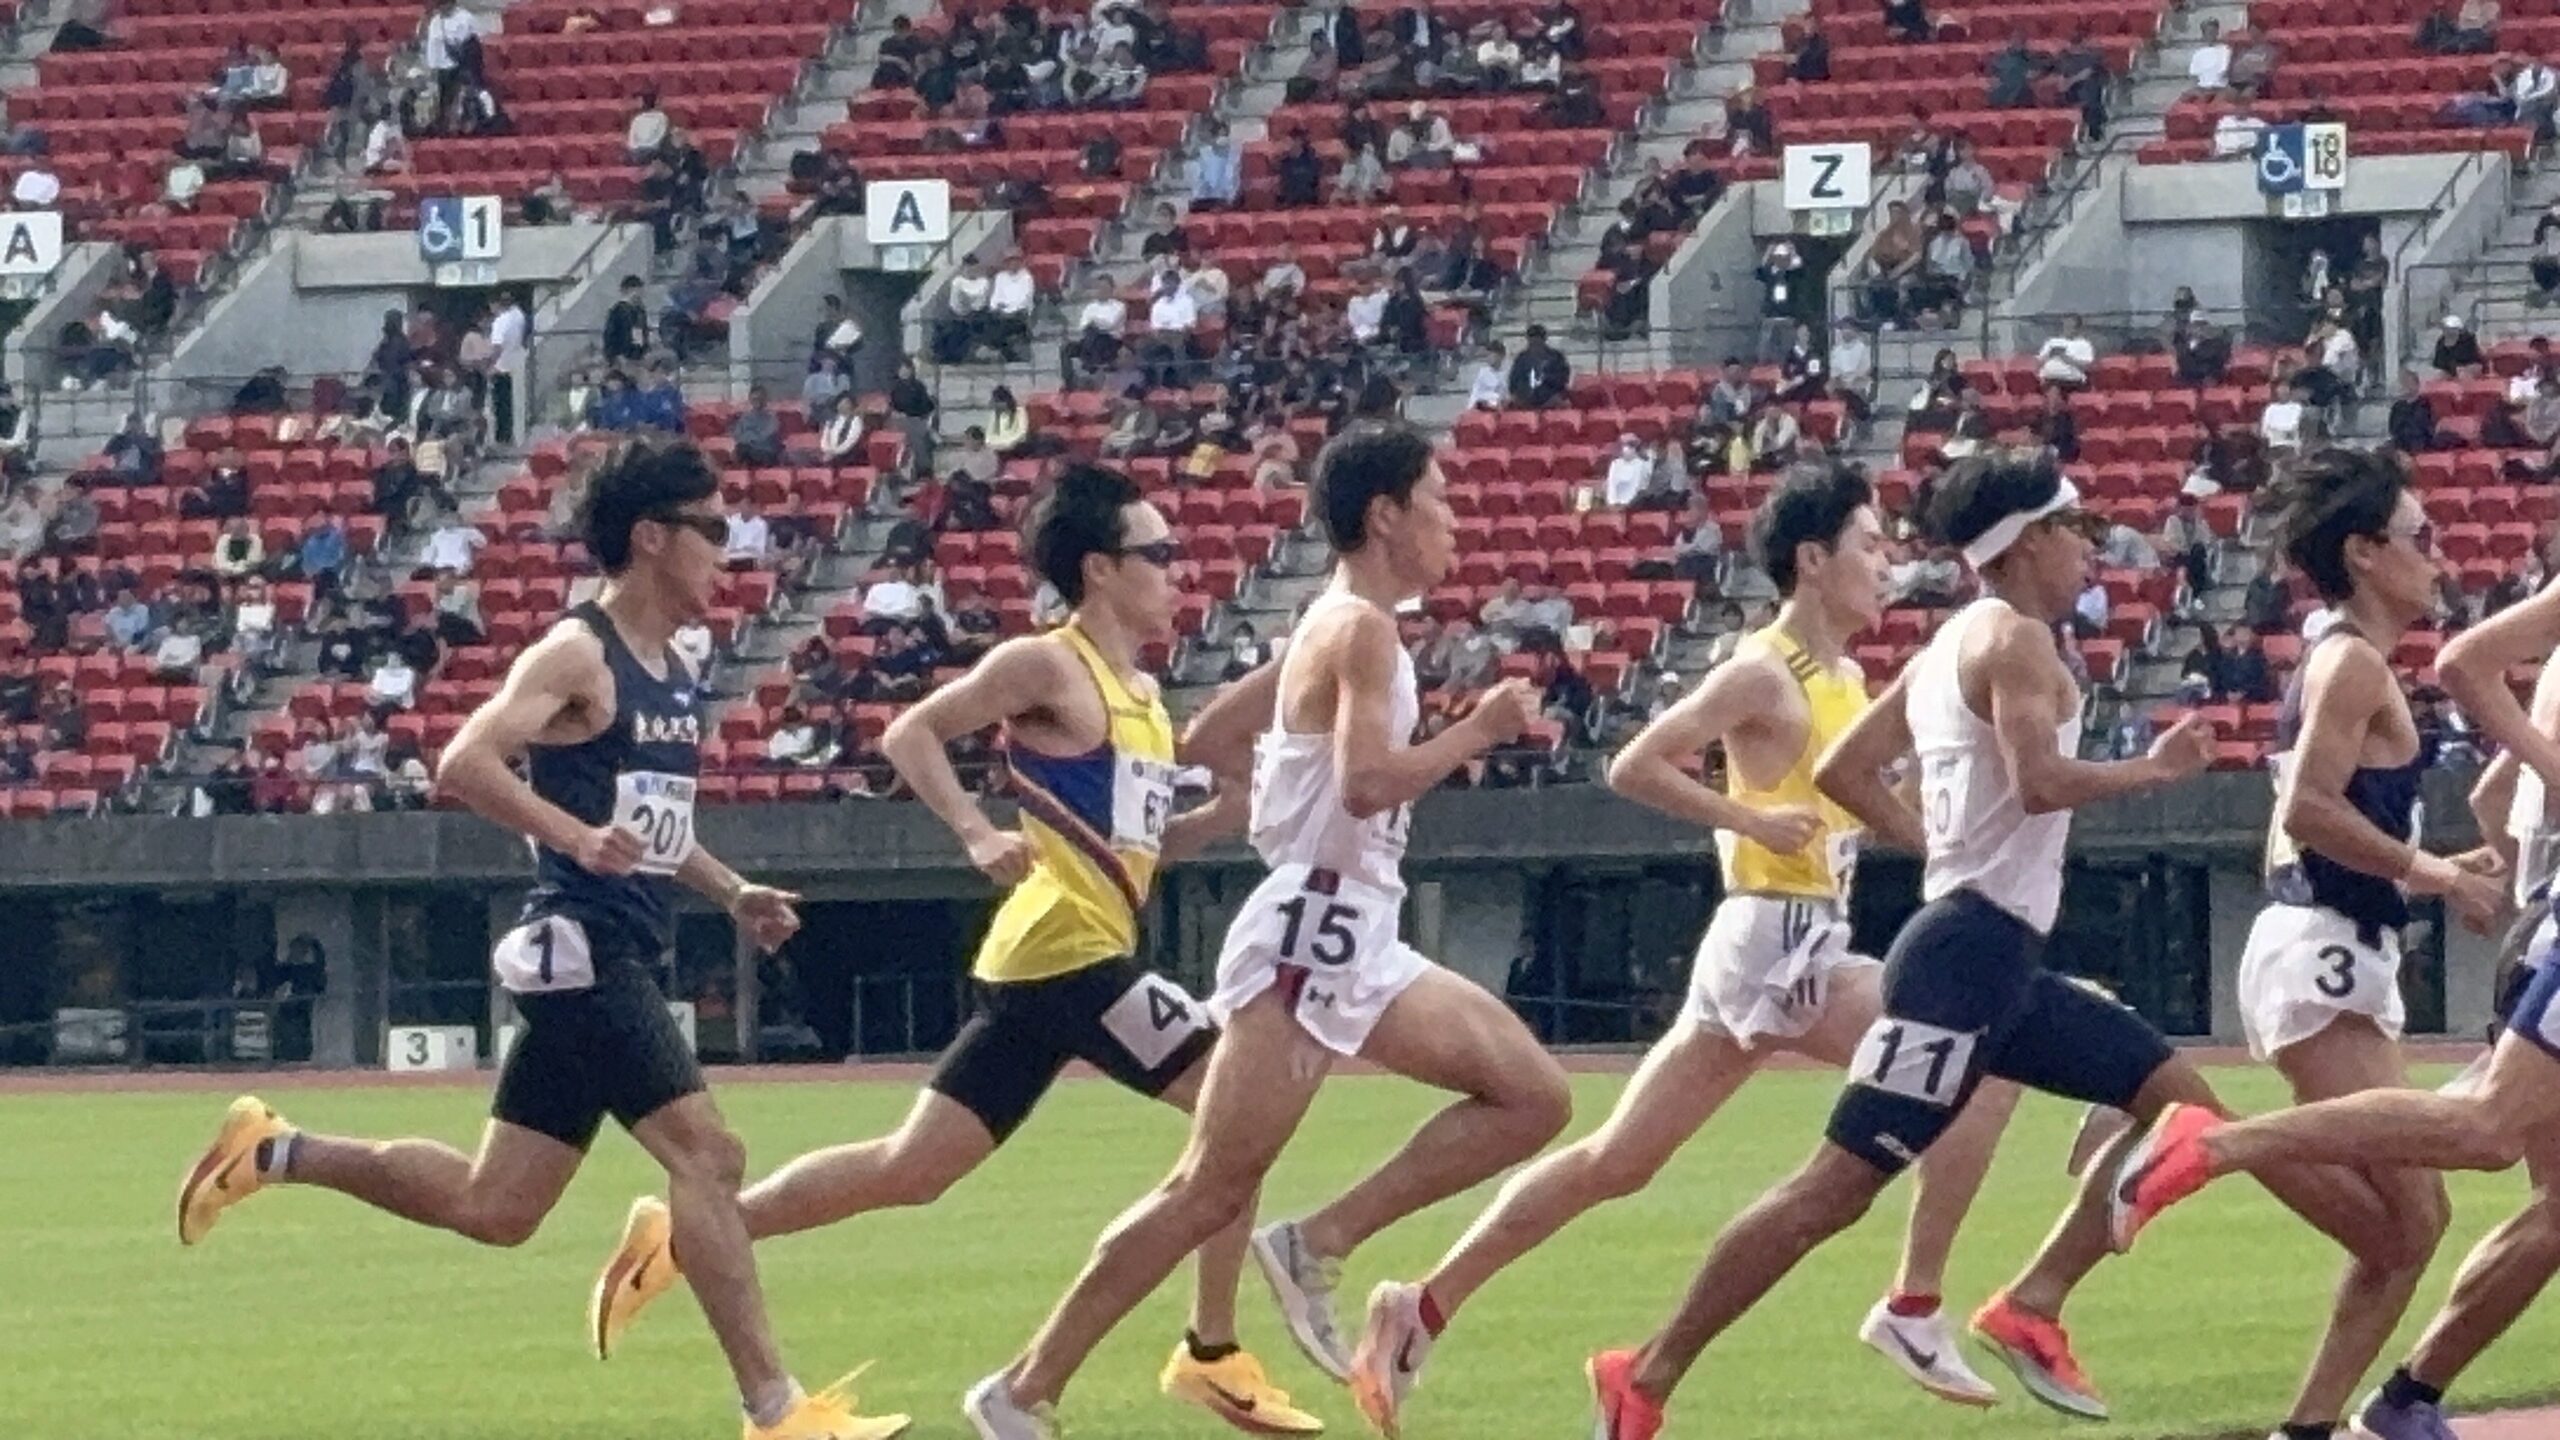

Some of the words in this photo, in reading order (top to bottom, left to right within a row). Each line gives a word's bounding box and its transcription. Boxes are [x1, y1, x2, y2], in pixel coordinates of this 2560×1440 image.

[1810, 154, 1843, 198] Z
[2312, 132, 2342, 179] 18
[471, 205, 487, 249] 1
[890, 190, 926, 233] A
[4, 222, 38, 264] A
[529, 923, 554, 985] 1
[1277, 896, 1360, 966] 15
[2314, 945, 2356, 999] 3
[1147, 986, 1190, 1032] 4
[406, 1031, 430, 1066] 3
[1874, 1026, 1956, 1096] 11
